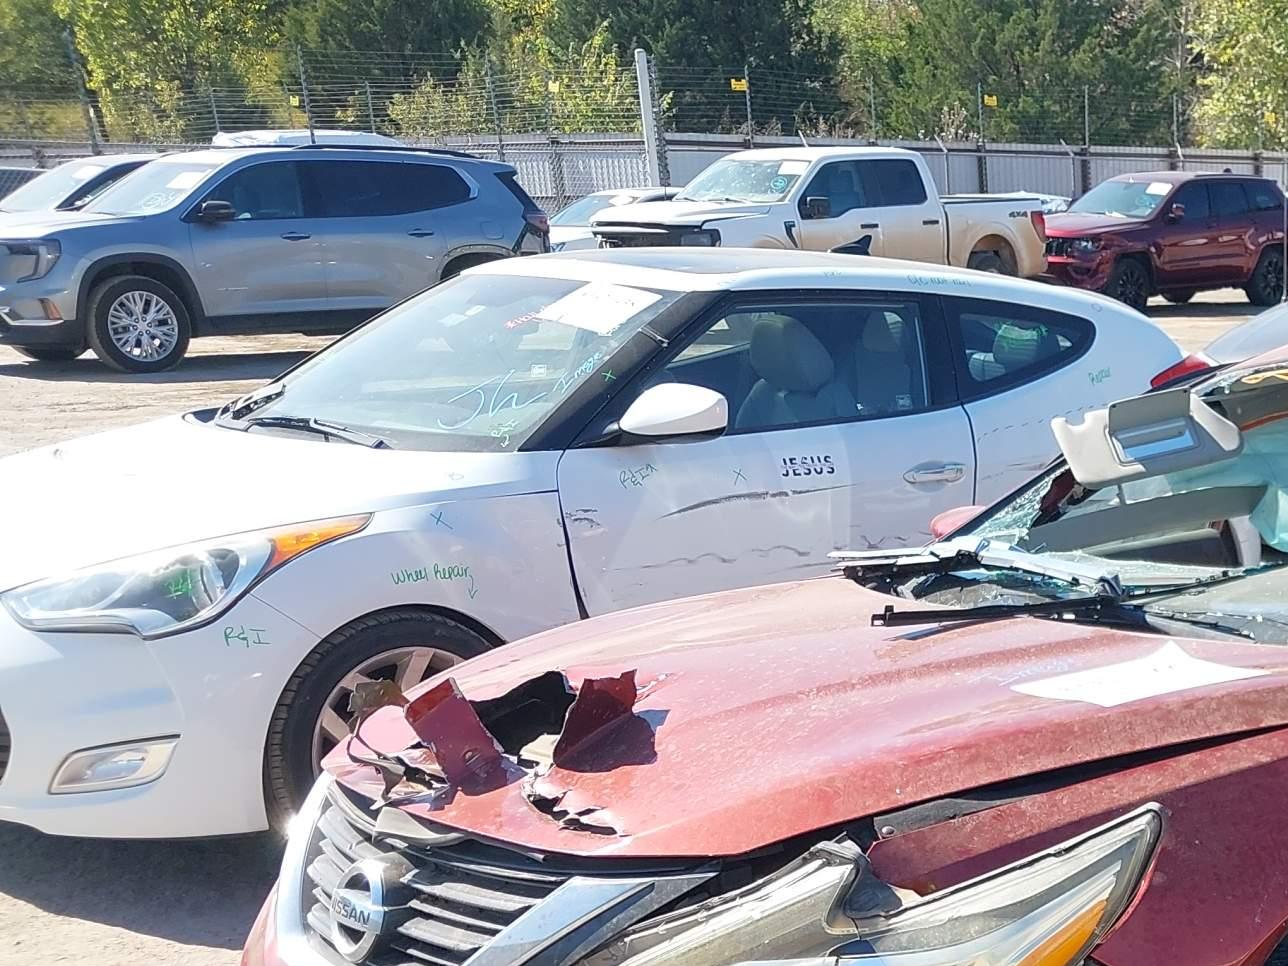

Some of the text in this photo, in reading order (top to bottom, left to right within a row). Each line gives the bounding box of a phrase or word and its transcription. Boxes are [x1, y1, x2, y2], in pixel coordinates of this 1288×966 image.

[781, 455, 835, 477] JESUS
[391, 562, 470, 584] Wheel Repair
